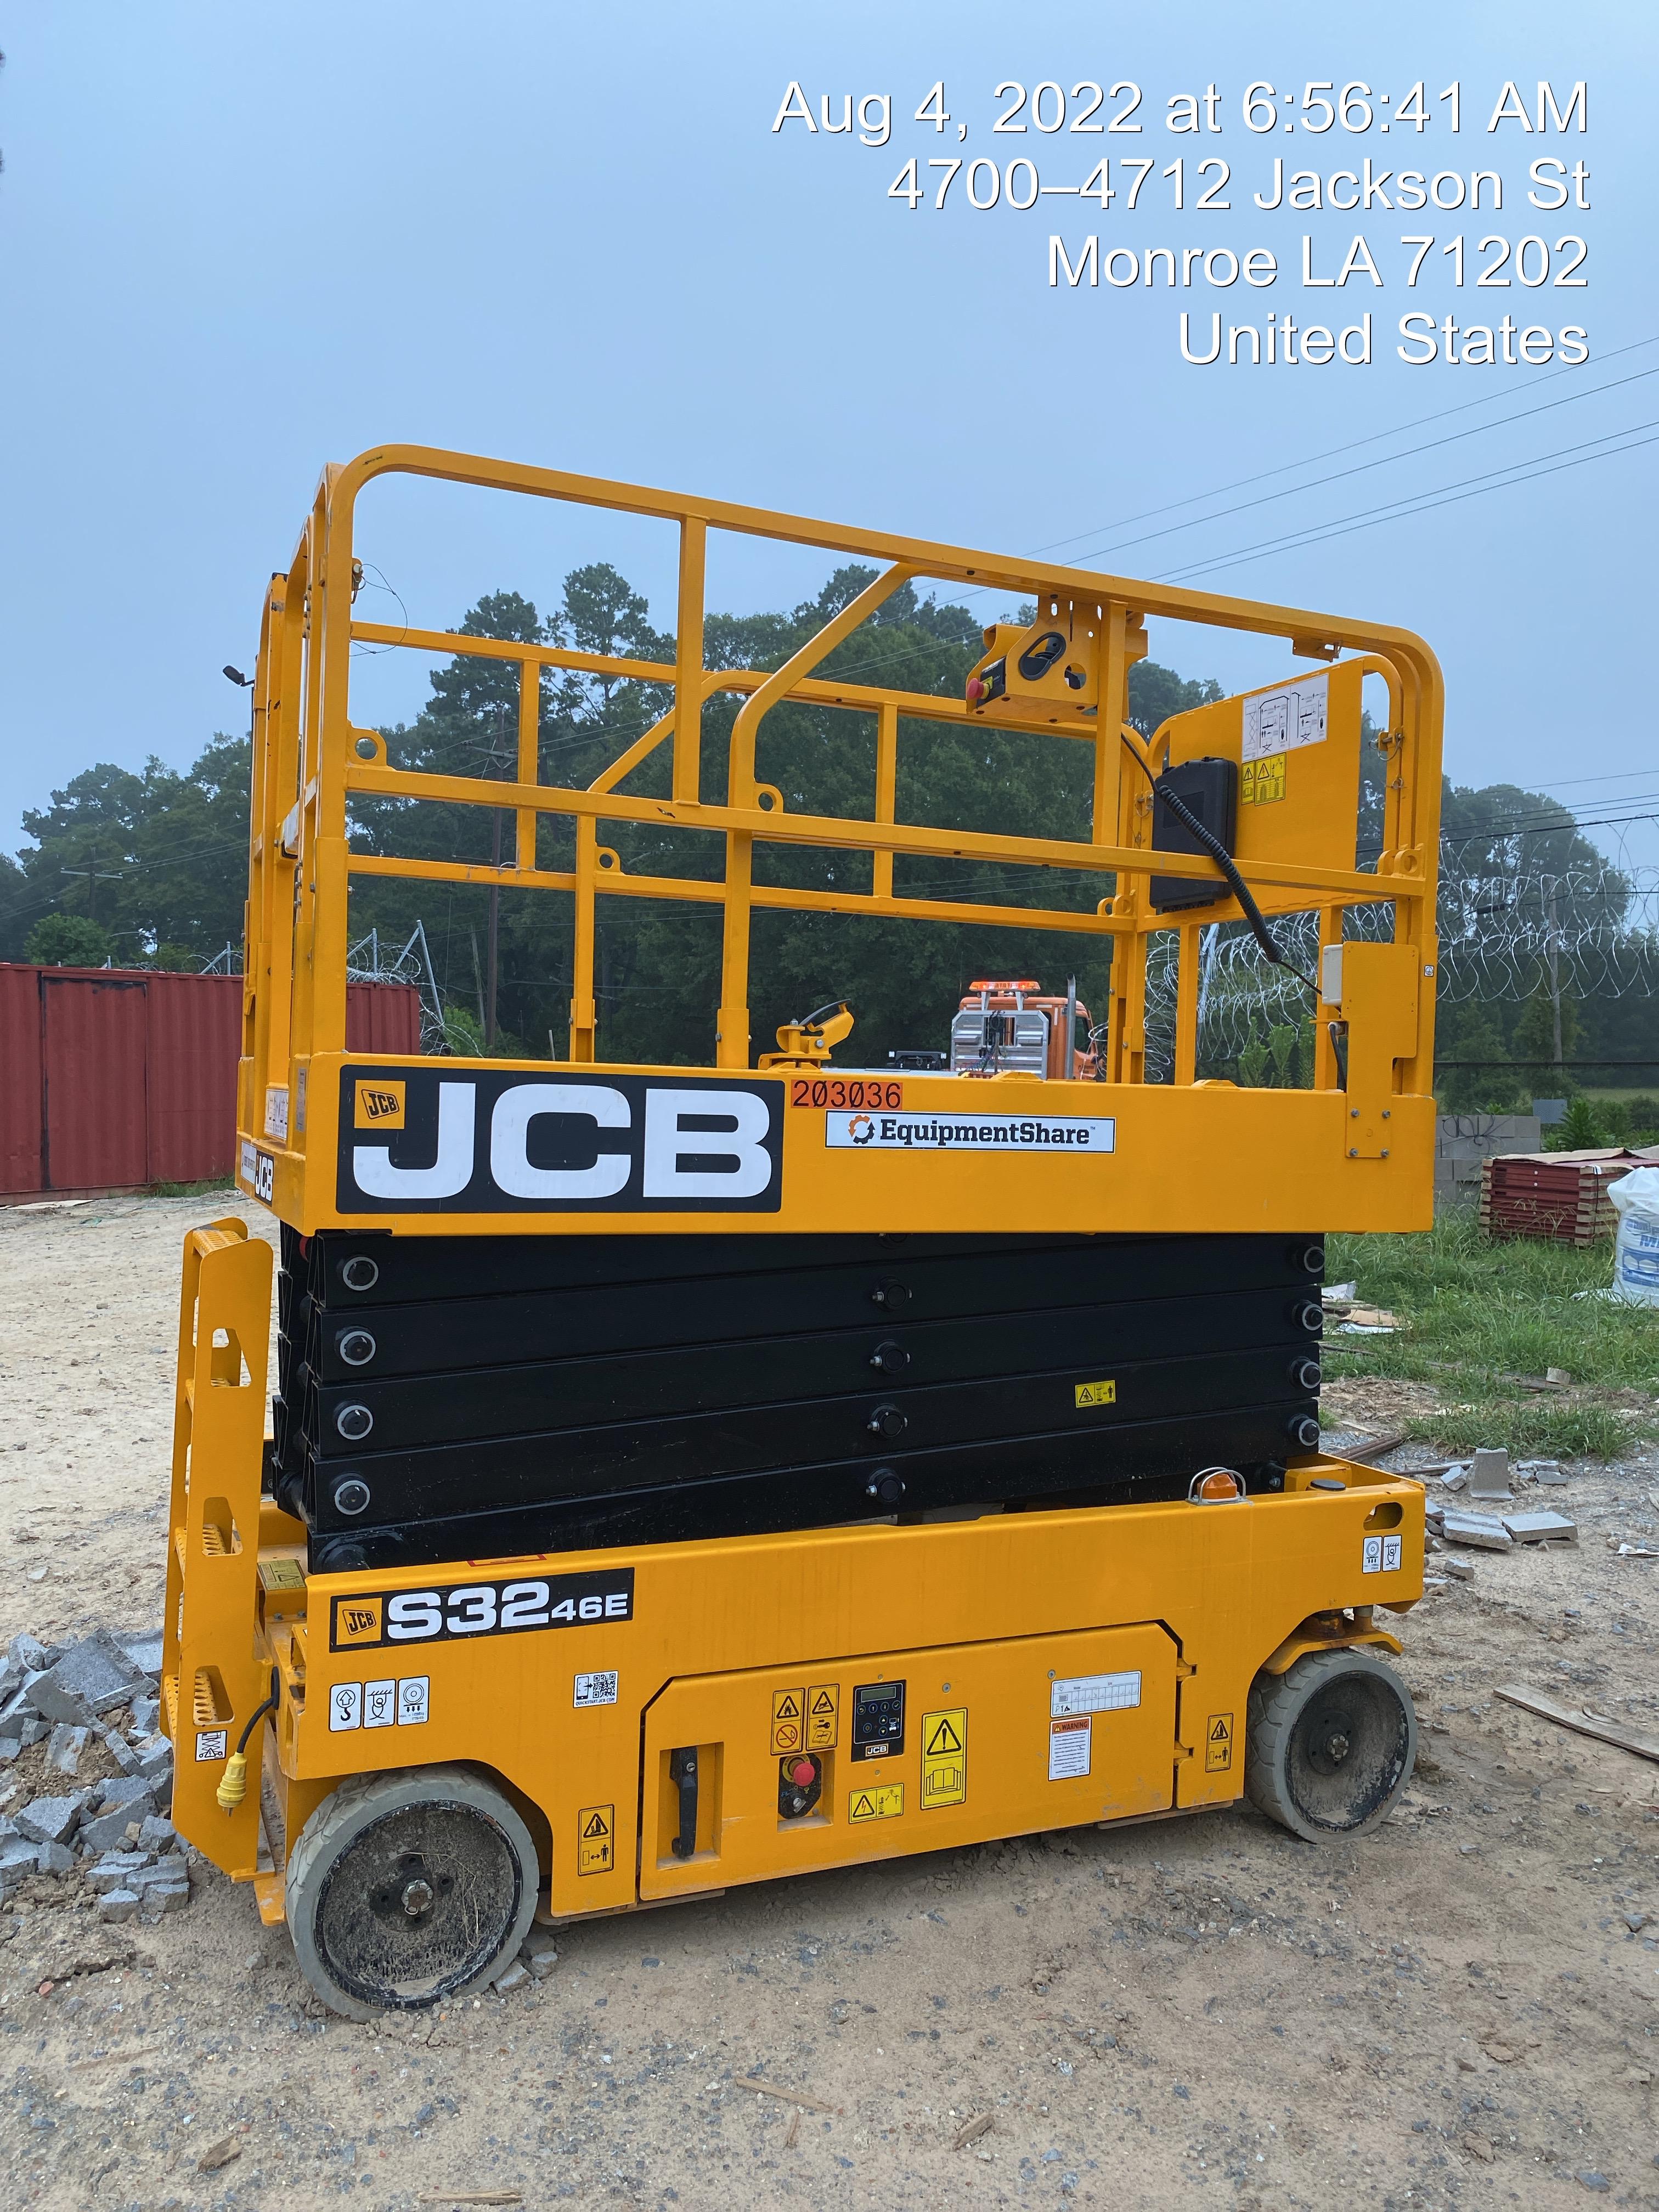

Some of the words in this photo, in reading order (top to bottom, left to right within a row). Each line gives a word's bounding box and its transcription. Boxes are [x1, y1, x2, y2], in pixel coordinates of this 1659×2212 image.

[368, 1092, 397, 1116] JCB
[793, 1080, 901, 1109] 203036
[353, 1082, 772, 1199] JCB
[879, 1118, 1090, 1147] EquipmentShare
[255, 1155, 273, 1201] JCB
[348, 1612, 374, 1632] JCB
[1062, 1721, 1088, 1730] WARNING
[867, 1746, 887, 1755] JCB
